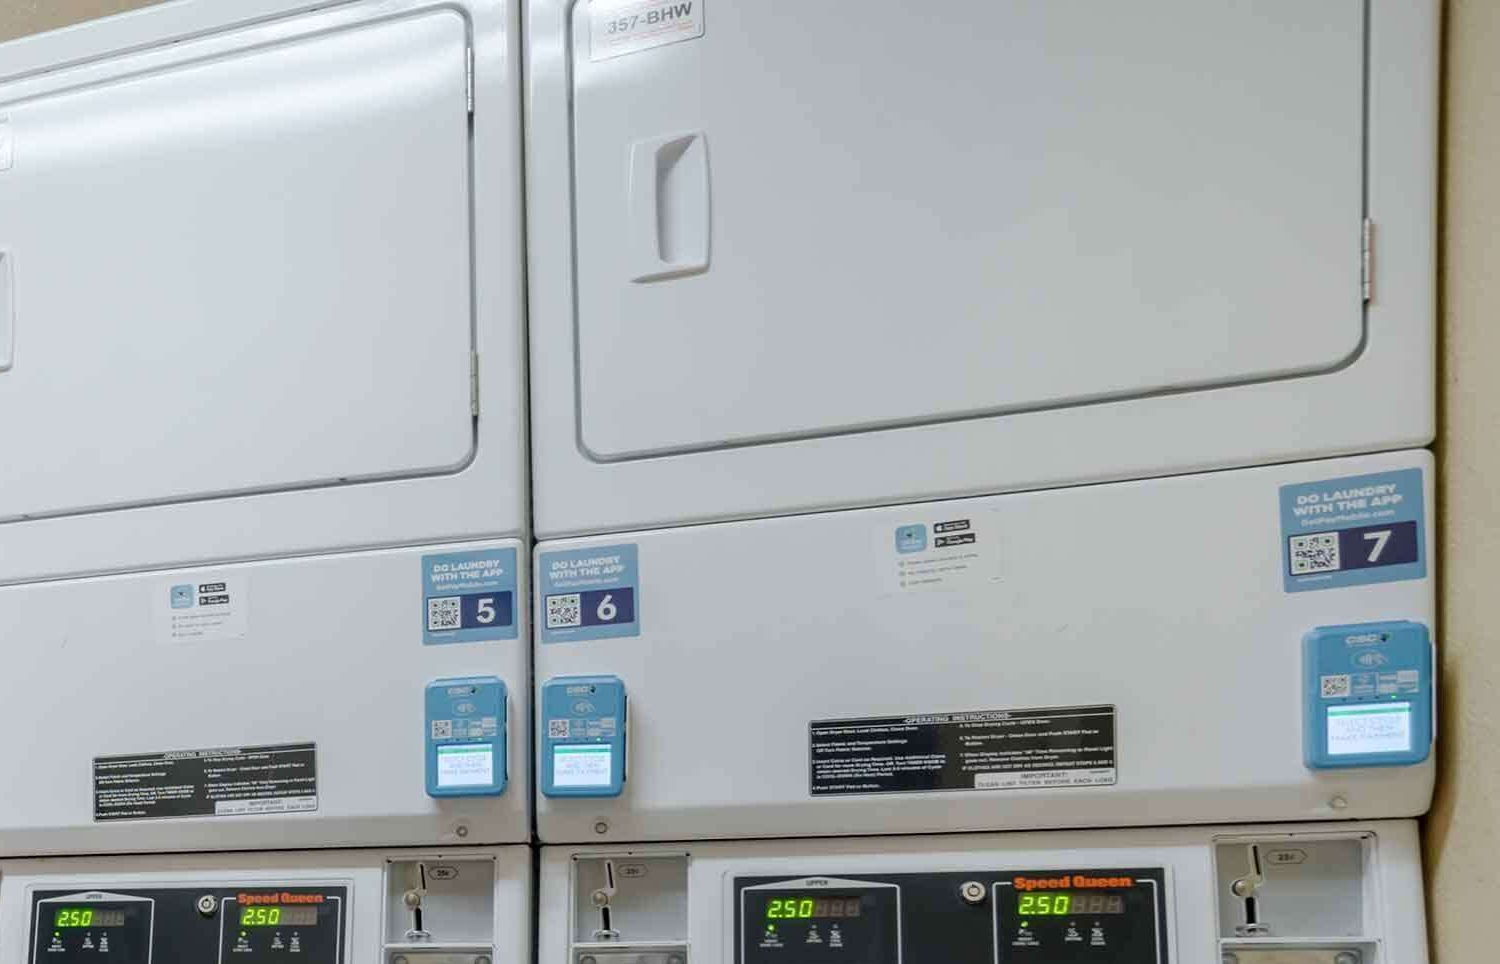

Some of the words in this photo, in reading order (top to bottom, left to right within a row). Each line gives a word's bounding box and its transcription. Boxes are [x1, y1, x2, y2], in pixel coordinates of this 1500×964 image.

[608, 1, 692, 34] 357-BHW
[1297, 494, 1318, 505] DO
[1324, 484, 1396, 502] LAUNDRY
[1293, 504, 1332, 516] WITH
[1338, 500, 1366, 511] THE
[1372, 494, 1402, 507] APP
[1364, 530, 1392, 562] 7
[434, 564, 449, 573] DO
[452, 560, 500, 572] LAUNDRY
[552, 562, 568, 570] DO
[570, 556, 620, 569] LAUNDRY
[431, 573, 458, 582] WITH
[462, 570, 482, 578] THE
[484, 568, 502, 578] APP
[550, 570, 577, 580] WITH
[580, 568, 600, 576] THE
[602, 565, 624, 574] APP
[476, 598, 496, 624] 5
[596, 594, 616, 620] 6
[1014, 876, 1070, 890] Speed
[1072, 876, 1132, 888] Queen
[238, 892, 278, 904] Speed
[280, 892, 324, 904] Queen
[1018, 896, 1069, 914] 2.50
[243, 908, 280, 925] 2.50
[768, 900, 812, 918] 2.50
[58, 911, 92, 926] 2.50
